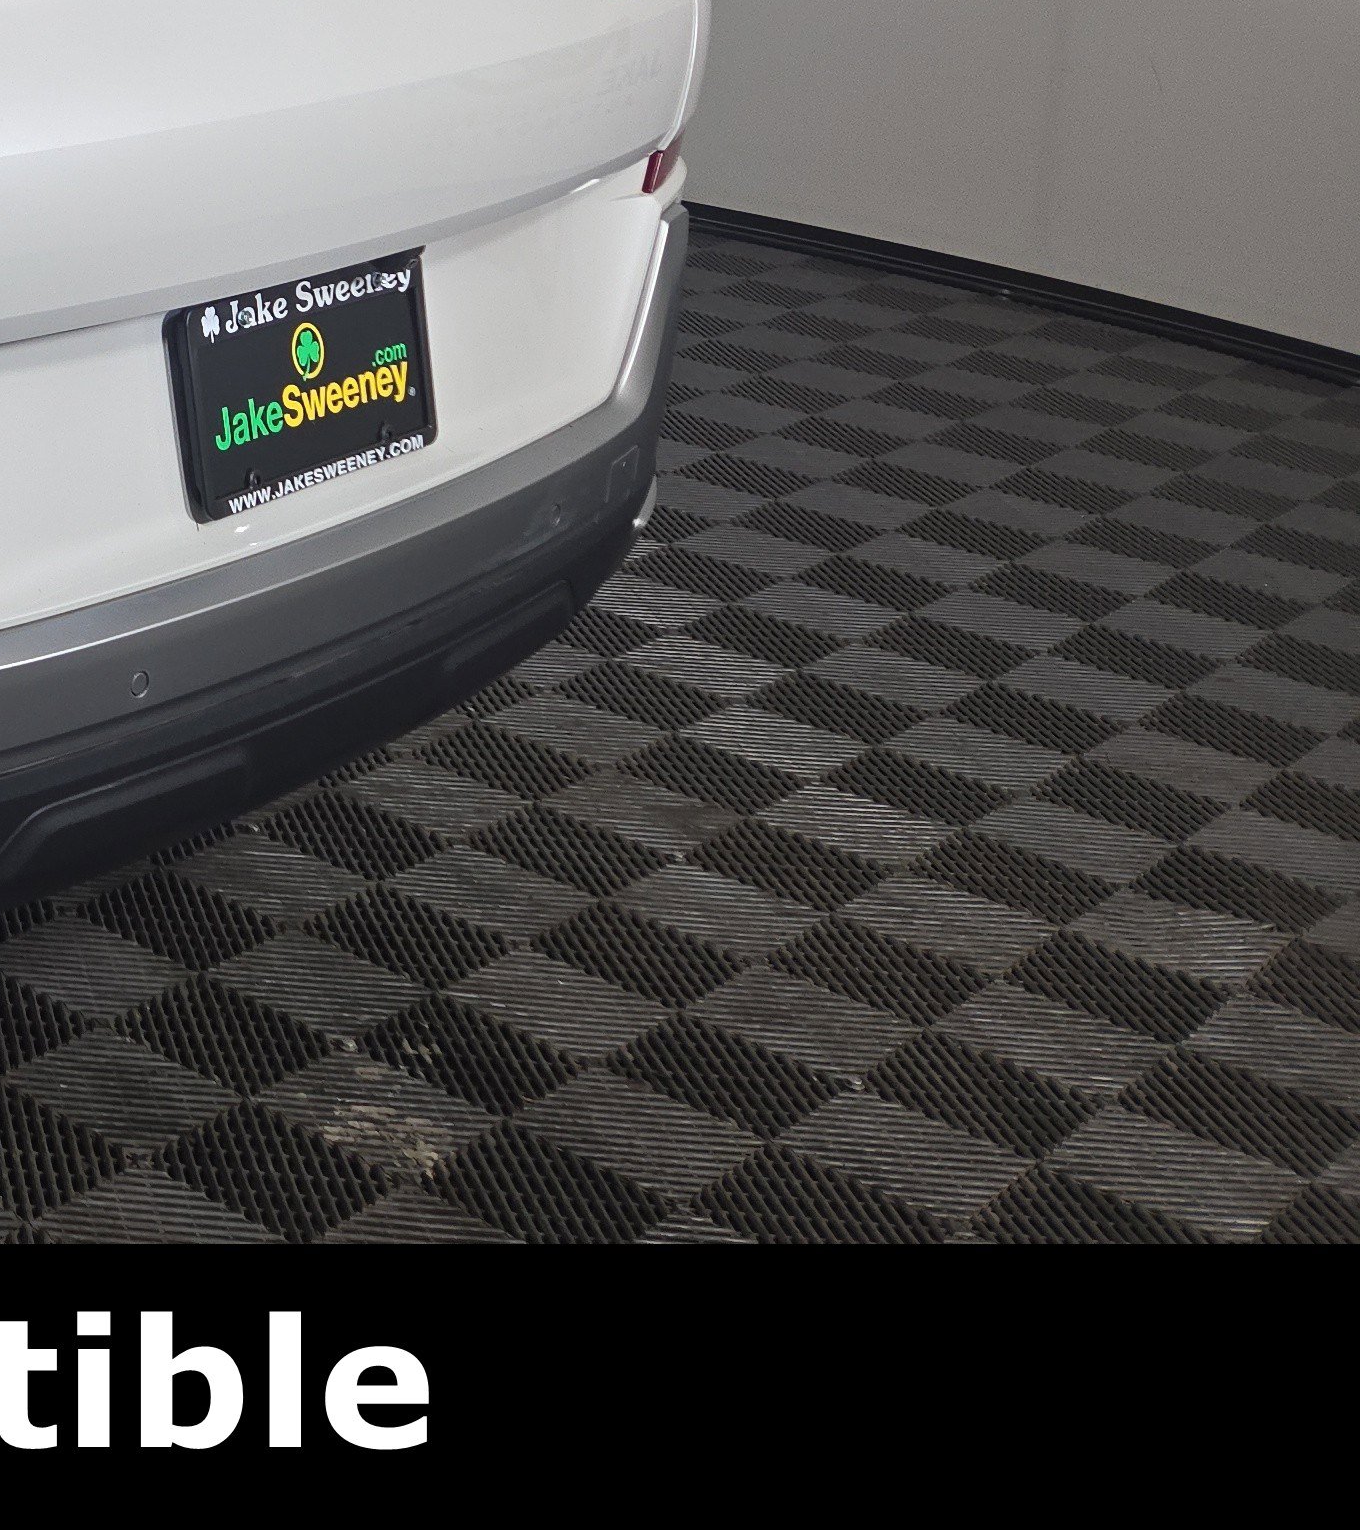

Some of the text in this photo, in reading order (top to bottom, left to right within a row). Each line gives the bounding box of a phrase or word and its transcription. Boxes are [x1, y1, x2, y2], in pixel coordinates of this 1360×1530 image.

[225, 293, 288, 333] Jake
[371, 343, 407, 367] .com
[228, 434, 424, 513] WWW.JAKESWEENEY.COM
